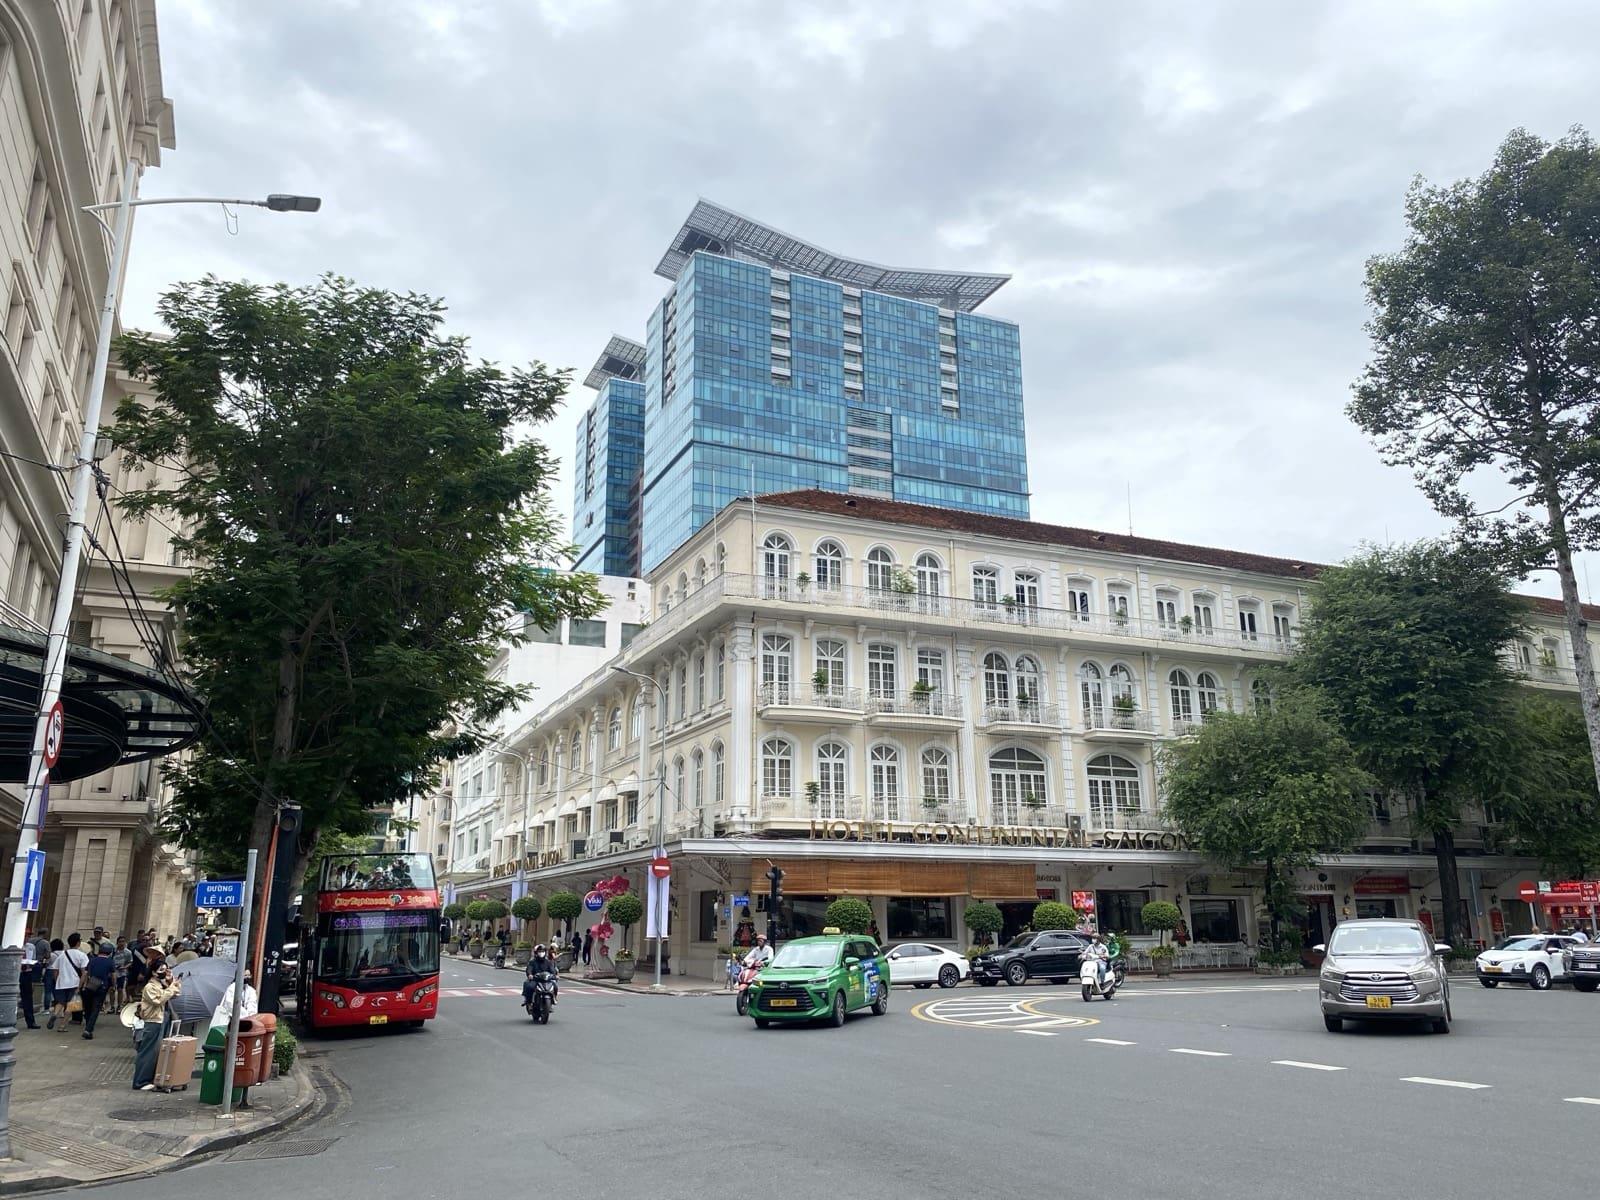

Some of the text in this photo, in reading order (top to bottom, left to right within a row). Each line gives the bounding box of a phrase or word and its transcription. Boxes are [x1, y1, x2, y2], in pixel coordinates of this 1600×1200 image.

[809, 819, 1191, 851] HOTEL CONTINENTAL SAIGON
[206, 884, 234, 893] ĐƯỜNG
[203, 894, 235, 906] LÊ LỢI
